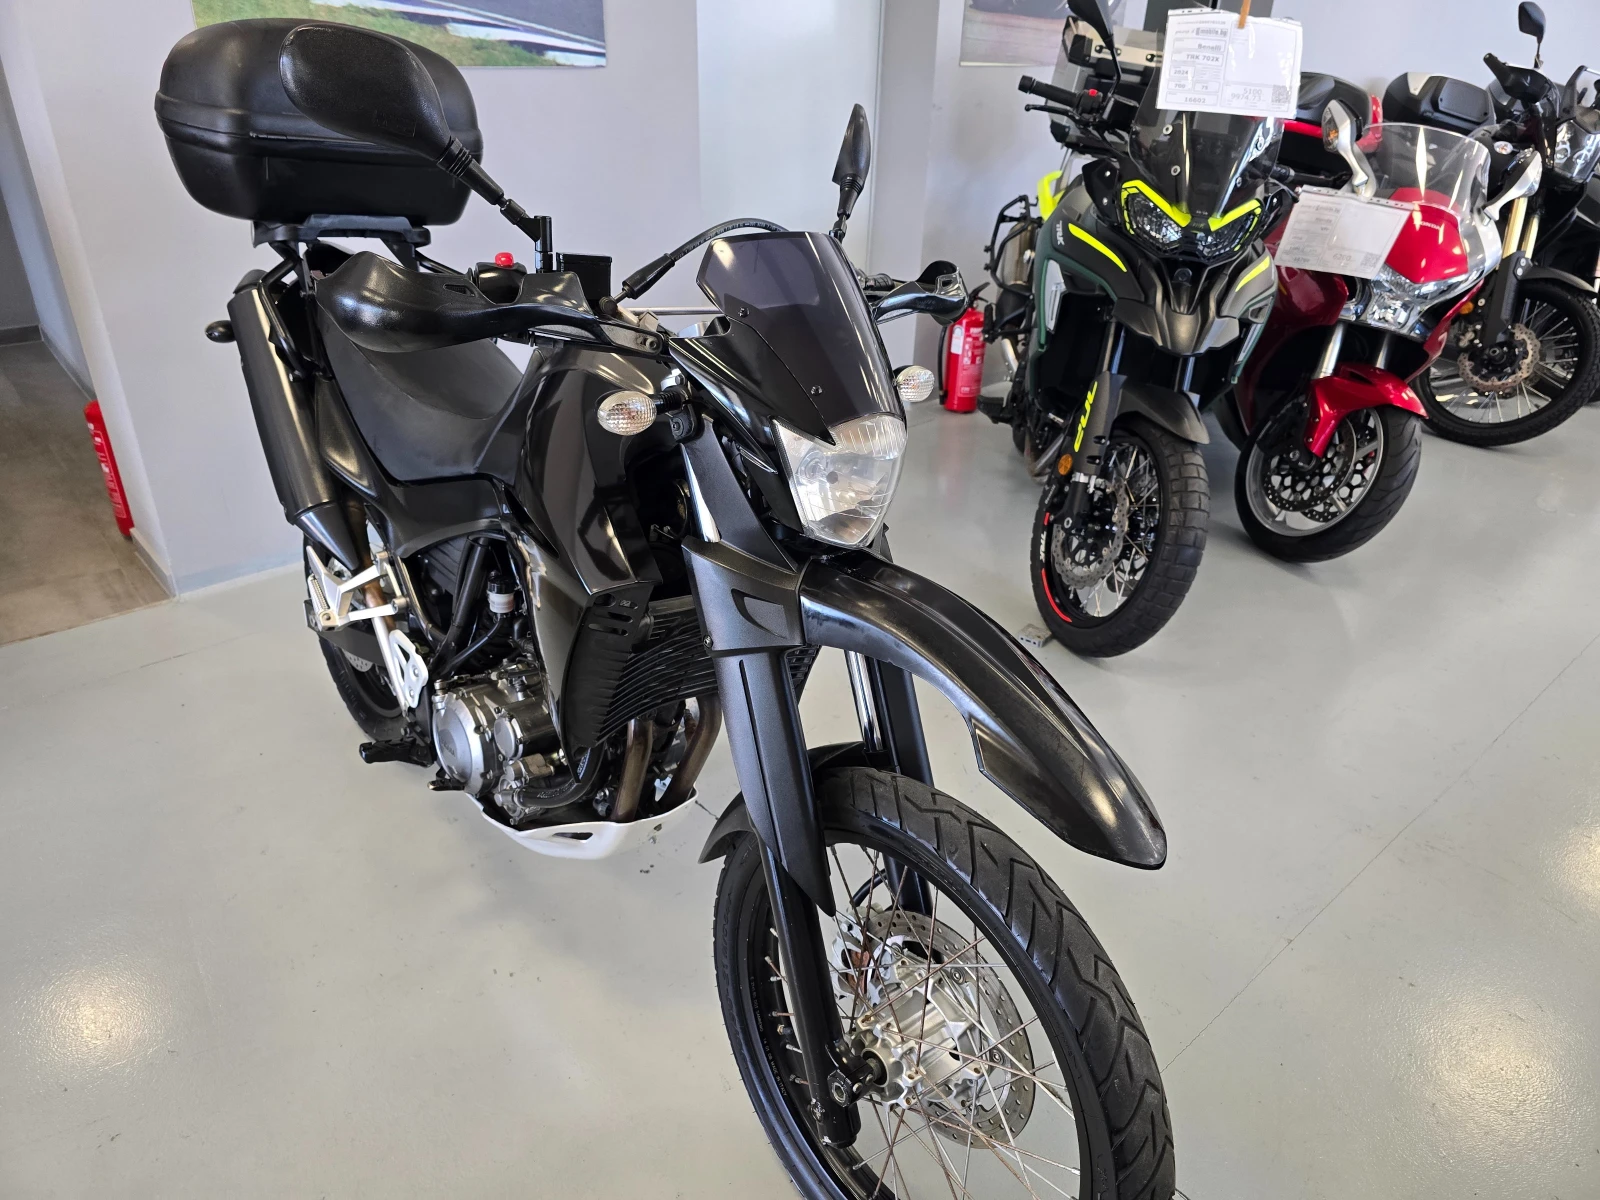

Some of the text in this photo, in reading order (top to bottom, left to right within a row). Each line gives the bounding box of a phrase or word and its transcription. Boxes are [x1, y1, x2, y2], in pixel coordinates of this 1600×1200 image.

[1198, 43, 1222, 52] Benelli
[1055, 220, 1065, 246] TRK
[1039, 531, 1047, 563] TRK
